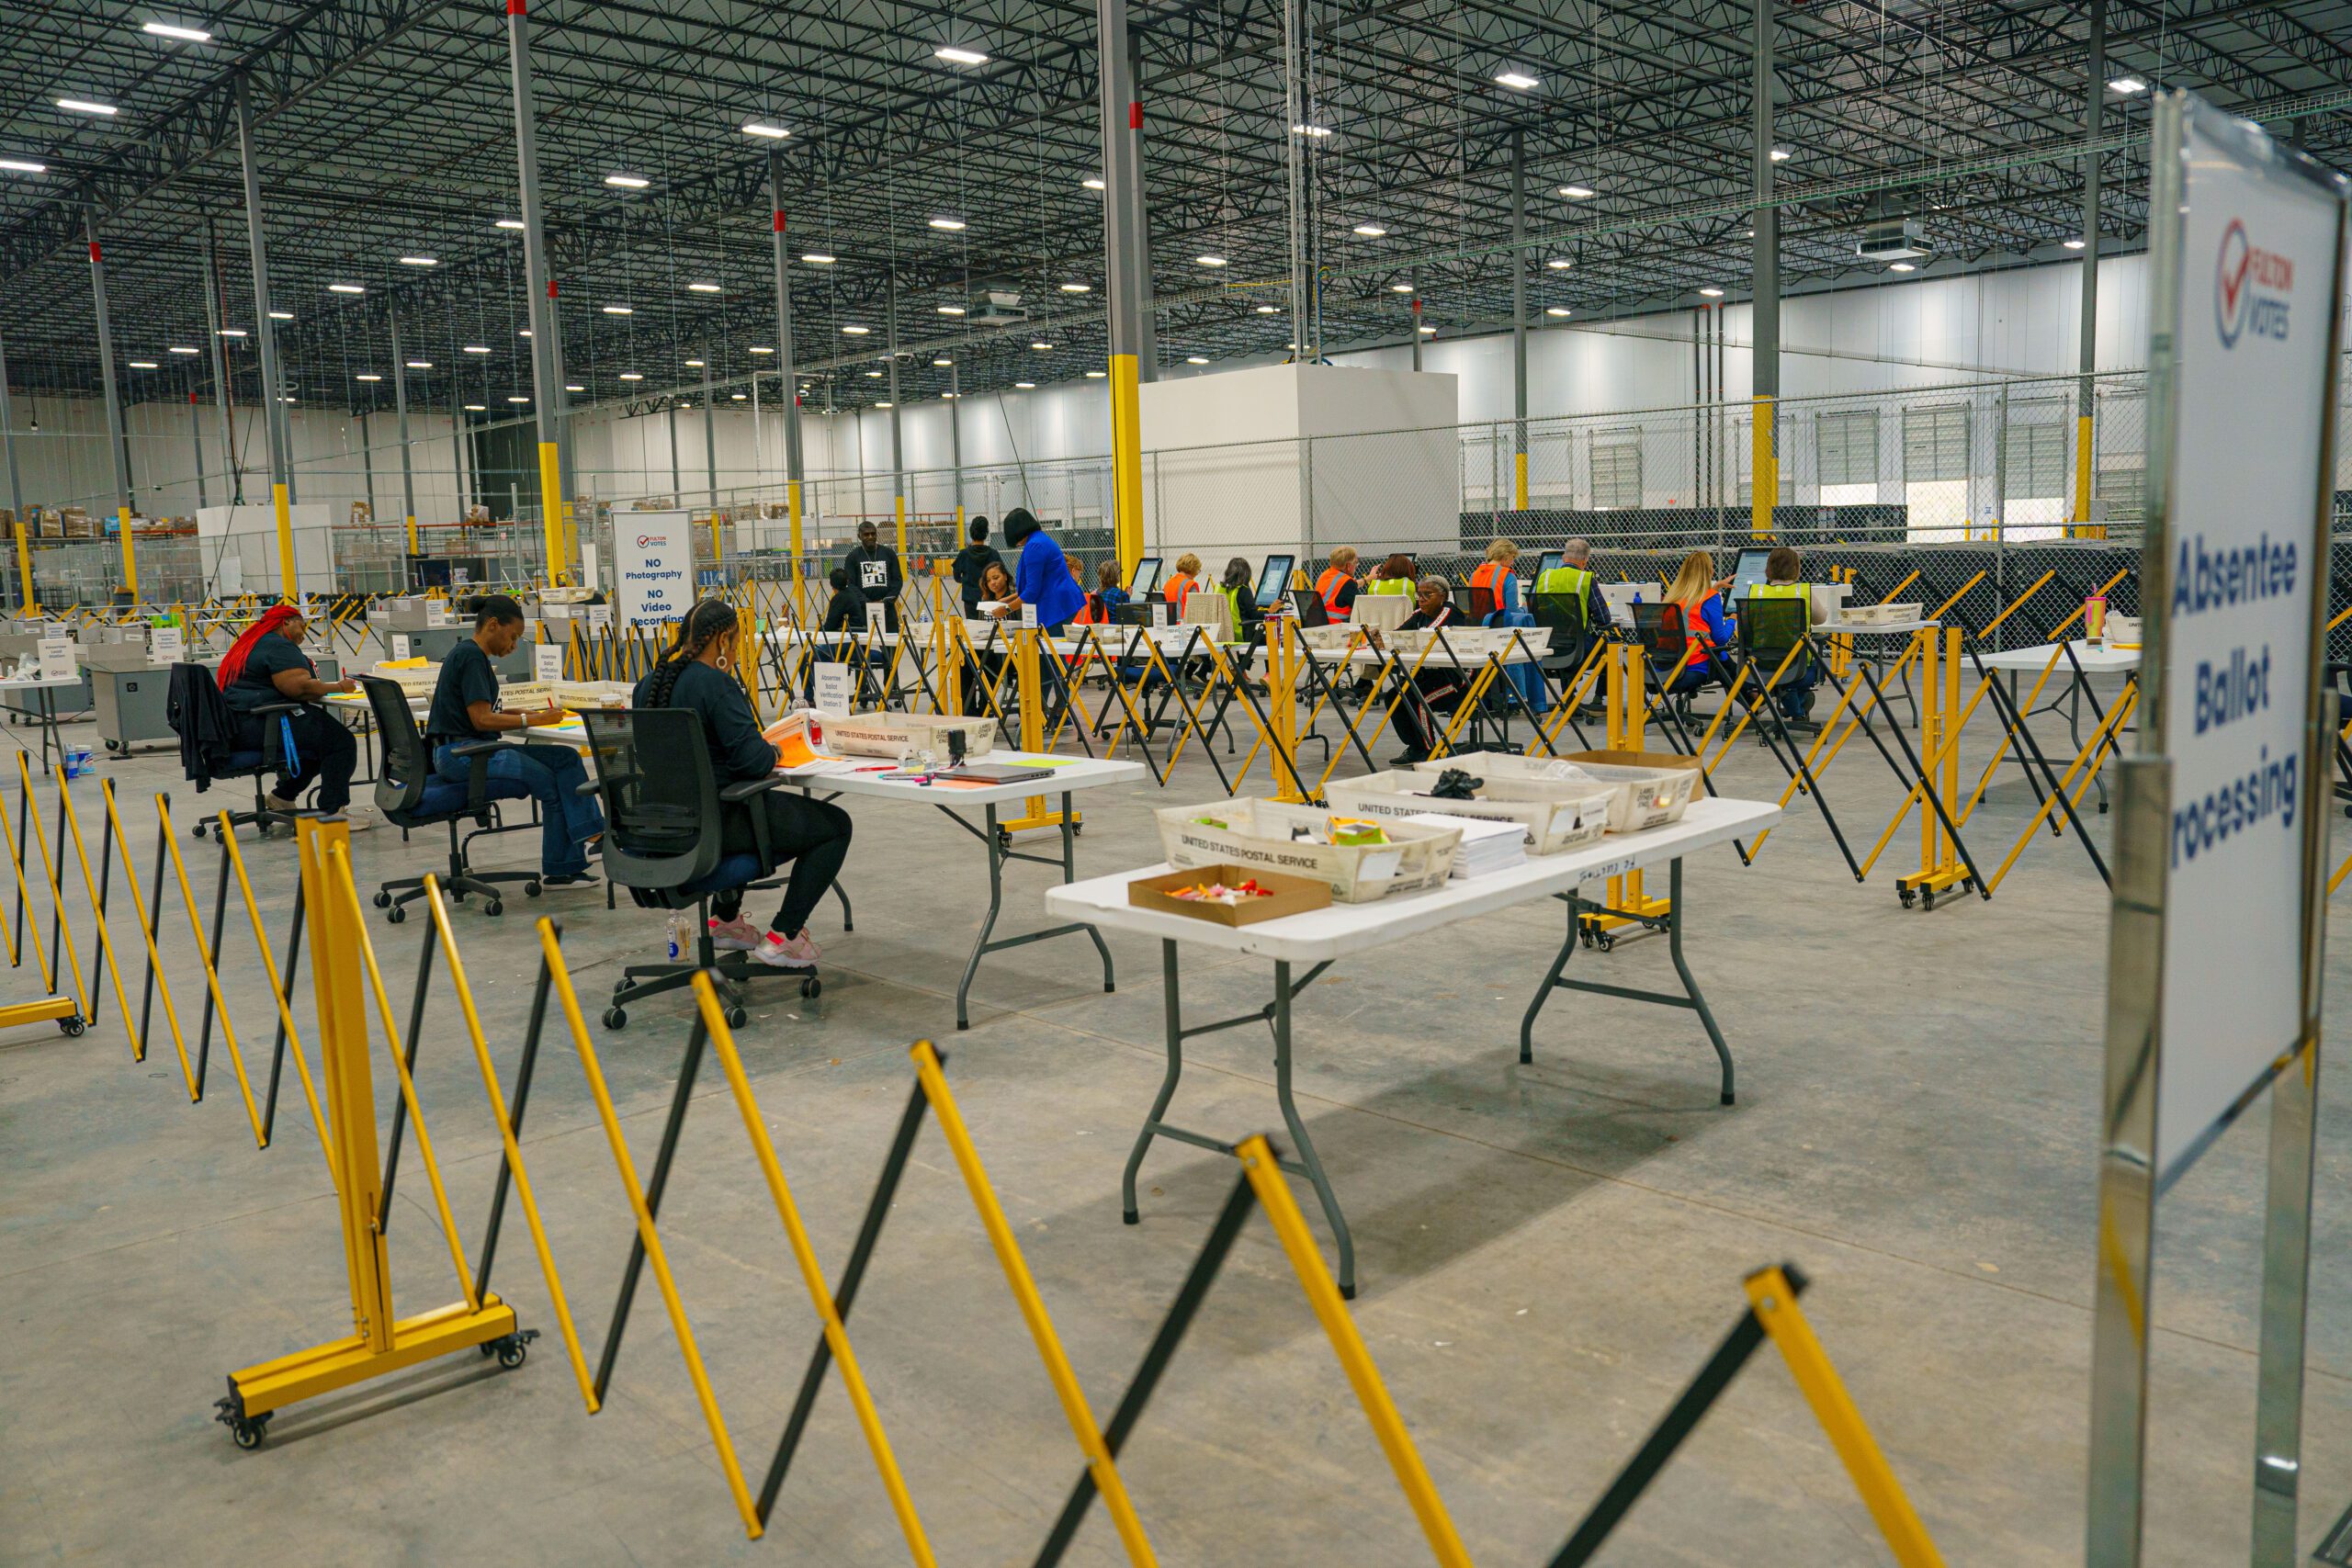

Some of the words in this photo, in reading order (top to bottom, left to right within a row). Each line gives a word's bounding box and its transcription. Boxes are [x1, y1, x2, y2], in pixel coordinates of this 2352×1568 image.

[2250, 244, 2294, 293] FULTON
[2248, 294, 2290, 342] VOTES
[645, 558, 662, 568] NO
[2171, 531, 2297, 619] Absentee
[626, 570, 682, 581] Photography
[648, 590, 663, 598] NO
[641, 603, 672, 613] Video
[2194, 643, 2270, 736] Ballot
[835, 729, 850, 739] UNITED
[851, 731, 867, 739] STATES
[868, 733, 887, 741] POSTAL
[1358, 803, 1391, 815] UNITED
[1394, 807, 1427, 817] STATE
[2171, 743, 2297, 870] rocessing
[1182, 834, 1208, 850] UNITED
[1210, 841, 1239, 856] STATES
[1241, 849, 1275, 863] POSTAL
[1277, 854, 1317, 869] SERVICE
